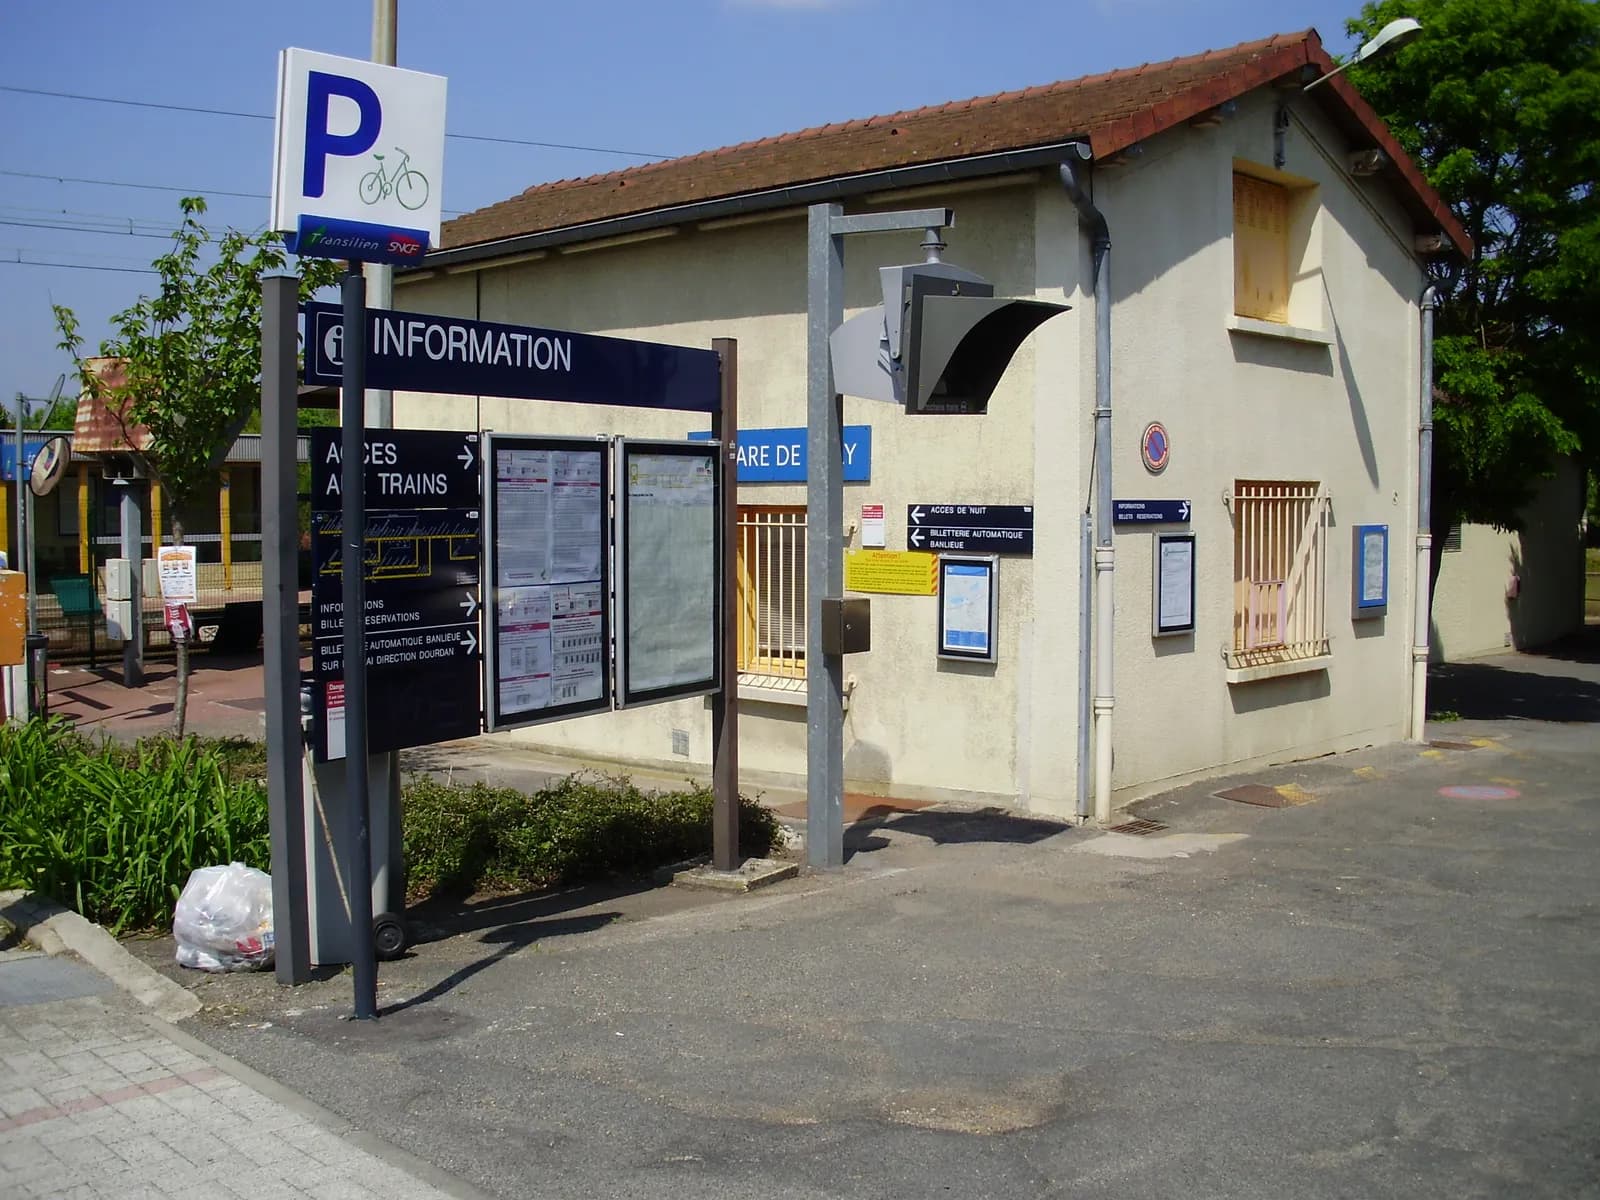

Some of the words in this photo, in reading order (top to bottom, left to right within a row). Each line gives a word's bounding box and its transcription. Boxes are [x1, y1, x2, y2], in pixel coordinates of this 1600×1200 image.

[303, 71, 382, 198] P
[311, 232, 379, 251] Transilien
[387, 241, 420, 254] SNCF
[374, 317, 571, 372] INFORMATION
[326, 441, 397, 464] AES
[737, 444, 770, 467] ARE
[777, 444, 801, 466] DE
[378, 473, 447, 495] TRAINS
[930, 506, 954, 514] ACCES
[930, 529, 970, 537] BILLETTERIE
[972, 530, 1023, 539] AUTOMATIQUE
[930, 541, 964, 549] BANLIEUE
[365, 612, 420, 625] ESERVATIONS
[370, 638, 423, 650] AUTOMATIQUE
[426, 632, 461, 643] BANLIEUE
[321, 661, 339, 671] SUR
[376, 652, 417, 665] DIRECTION
[419, 647, 455, 660] DOURDAN
